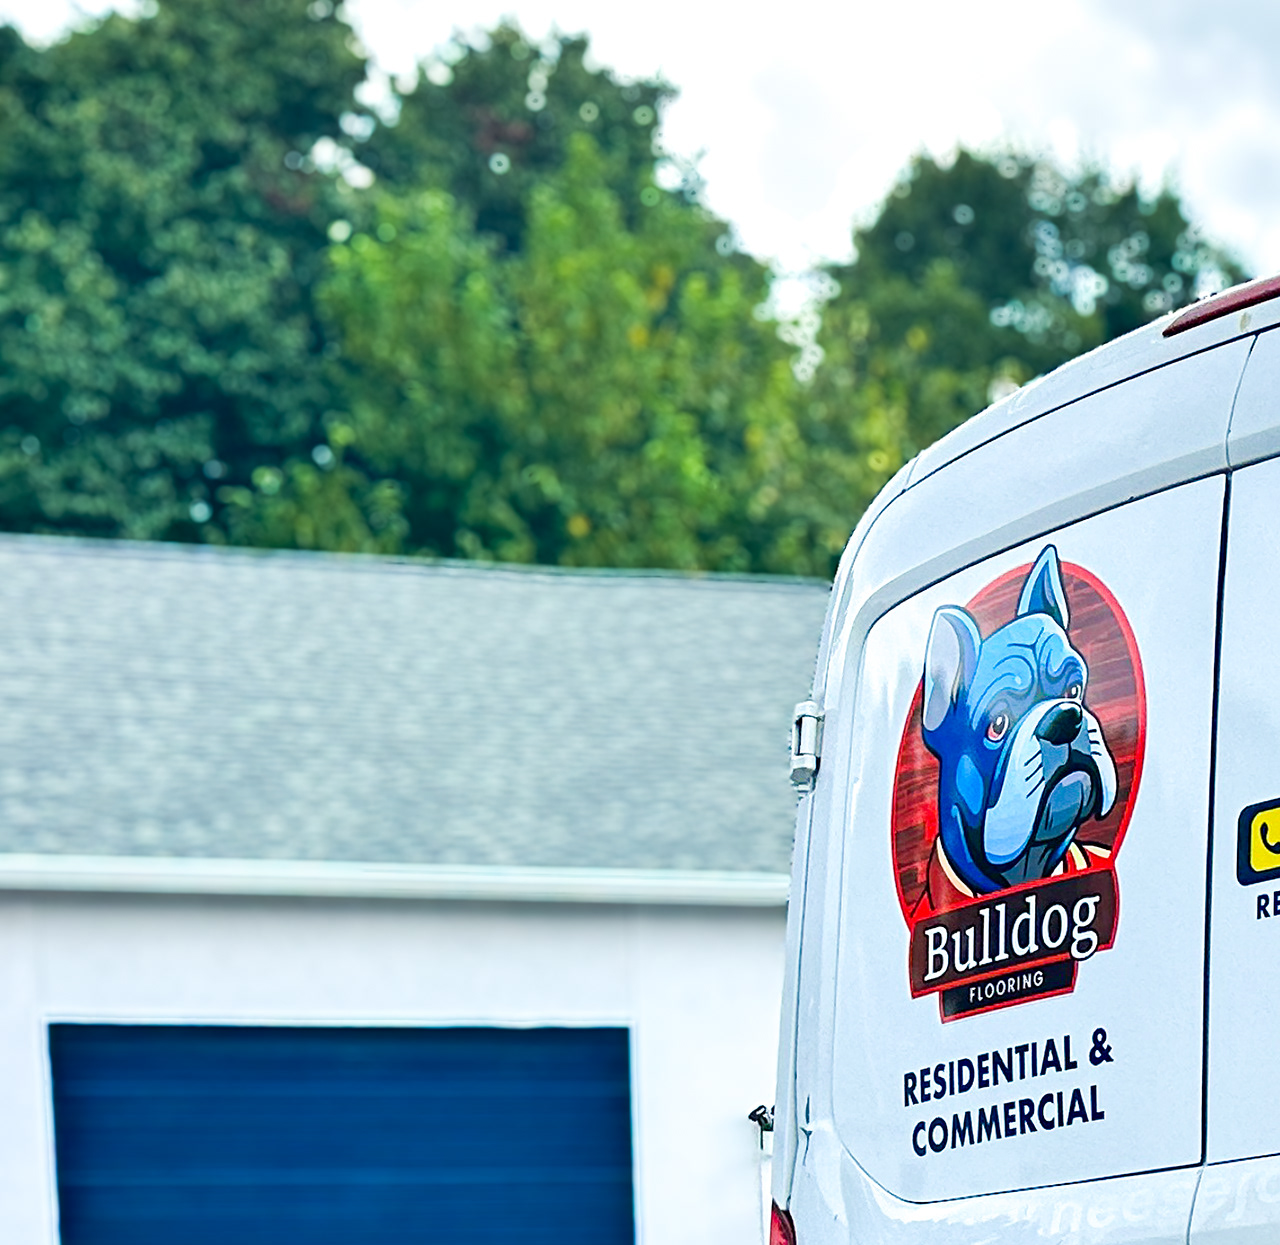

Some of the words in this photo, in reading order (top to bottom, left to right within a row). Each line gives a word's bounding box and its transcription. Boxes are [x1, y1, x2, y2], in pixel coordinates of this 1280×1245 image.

[923, 895, 1101, 982] Bulldog
[969, 970, 1044, 1003] FLOORING
[903, 1035, 1078, 1108] RESIDENTIAL
[1089, 1027, 1114, 1066] &
[912, 1085, 1106, 1157] COMMERCIAL
